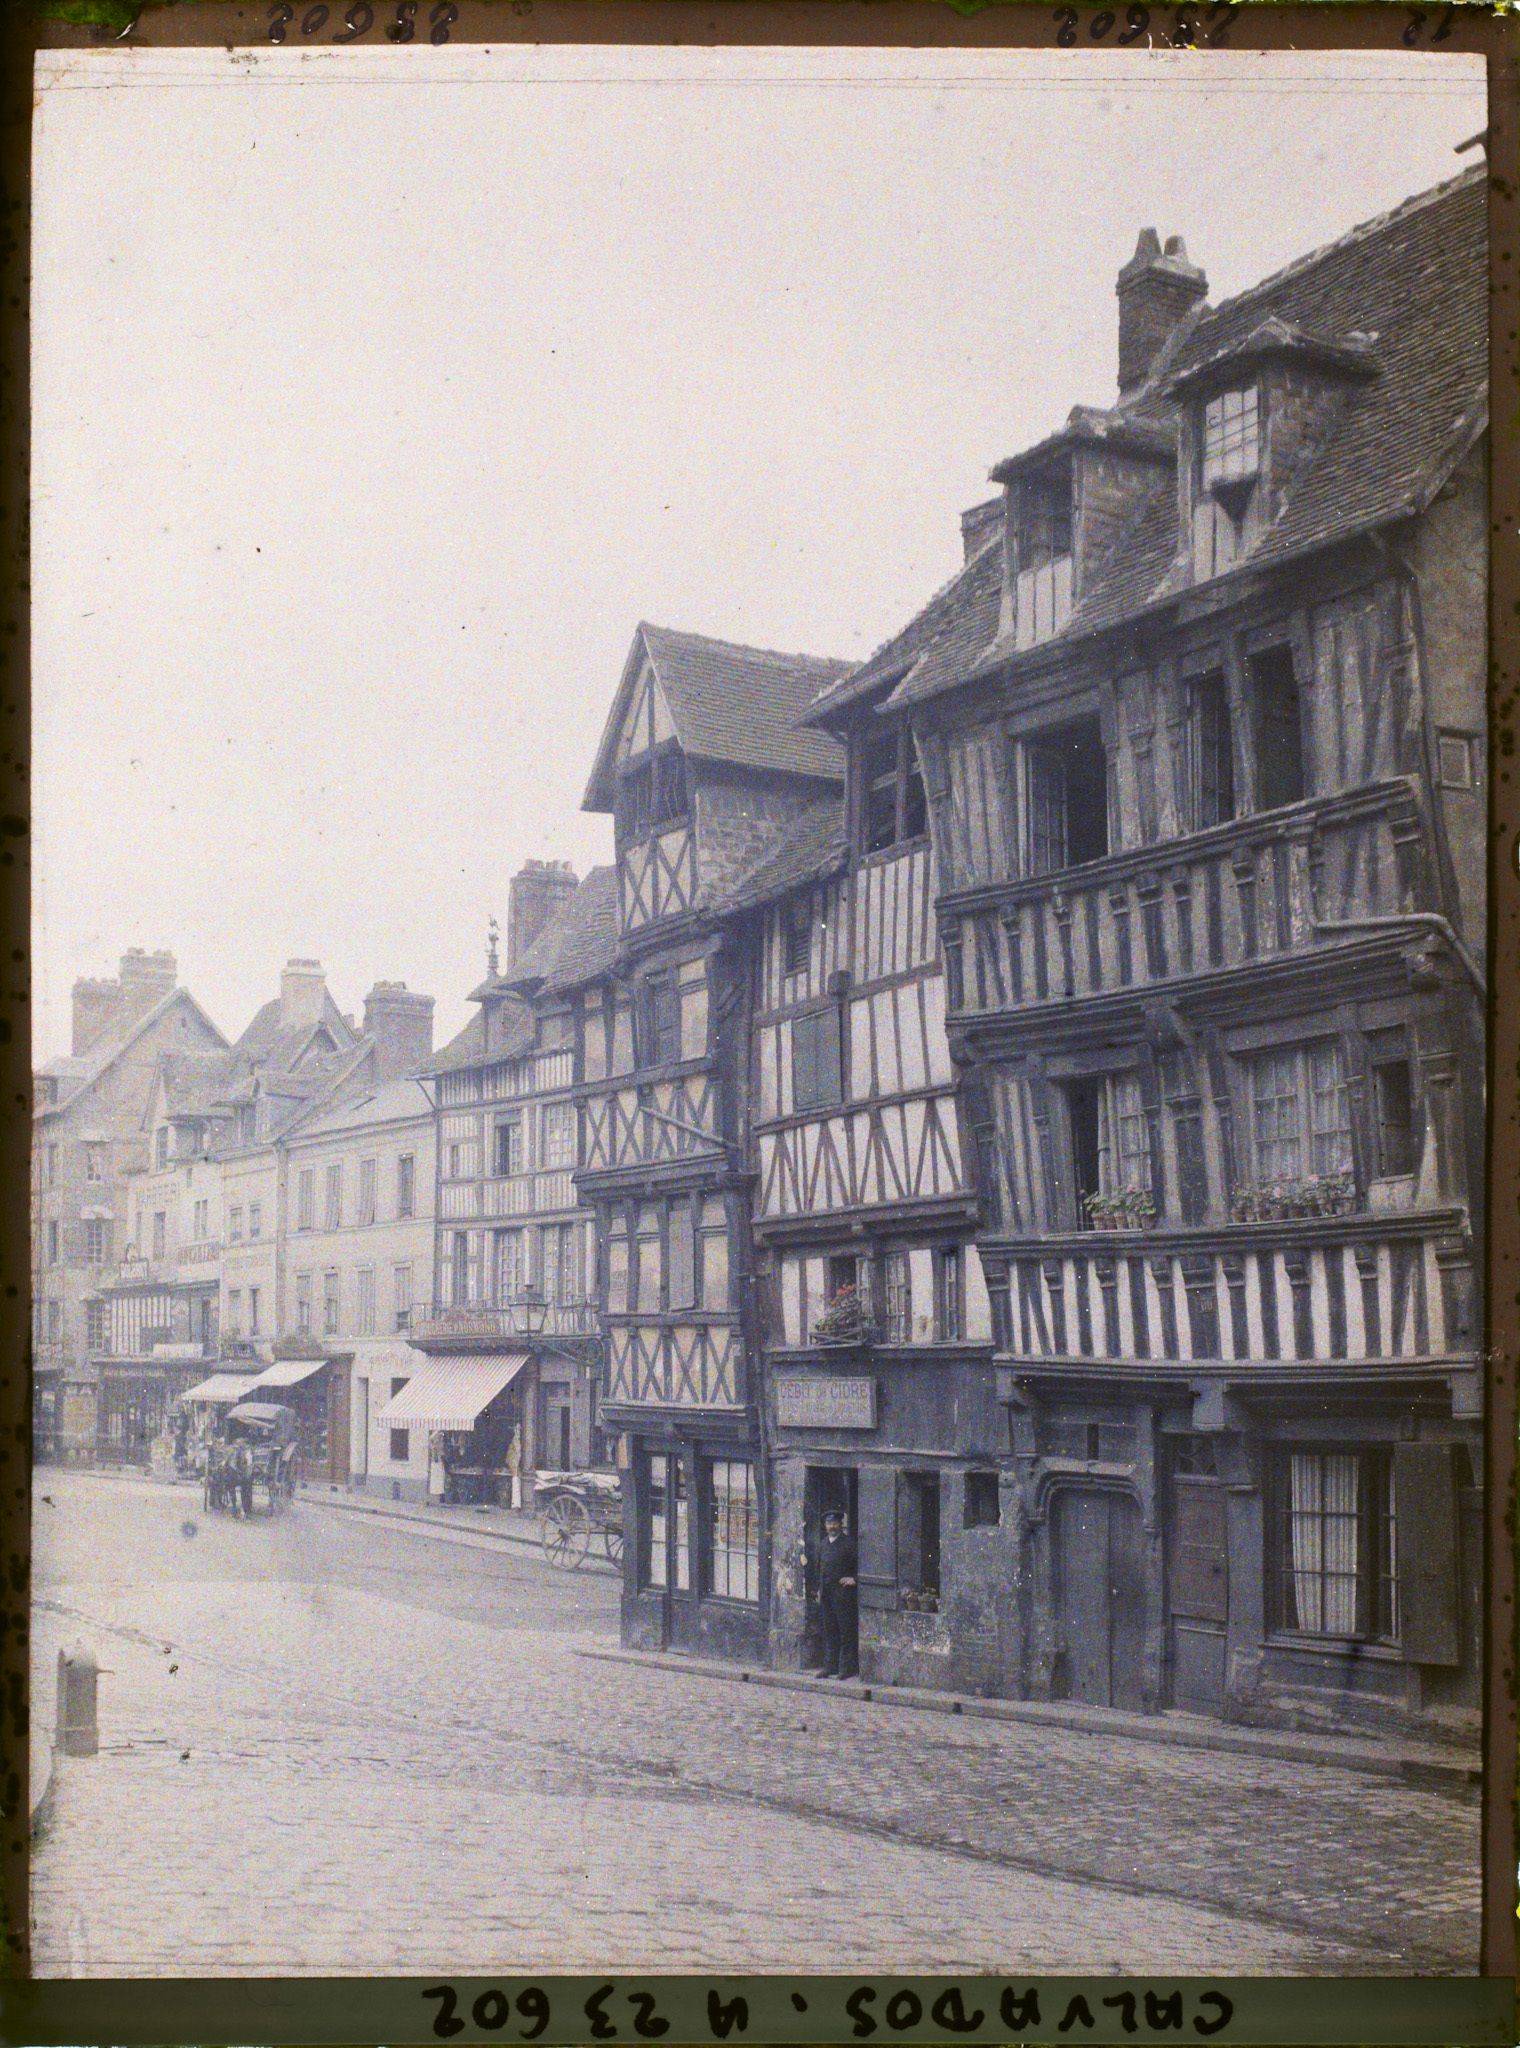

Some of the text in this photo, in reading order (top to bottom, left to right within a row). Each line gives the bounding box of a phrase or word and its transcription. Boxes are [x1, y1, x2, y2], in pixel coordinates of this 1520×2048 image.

[830, 1381, 868, 1400] CIDRE
[421, 1985, 550, 2040] 602
[584, 1985, 671, 2039] 23
[846, 1986, 1234, 2038] CALVADOS
